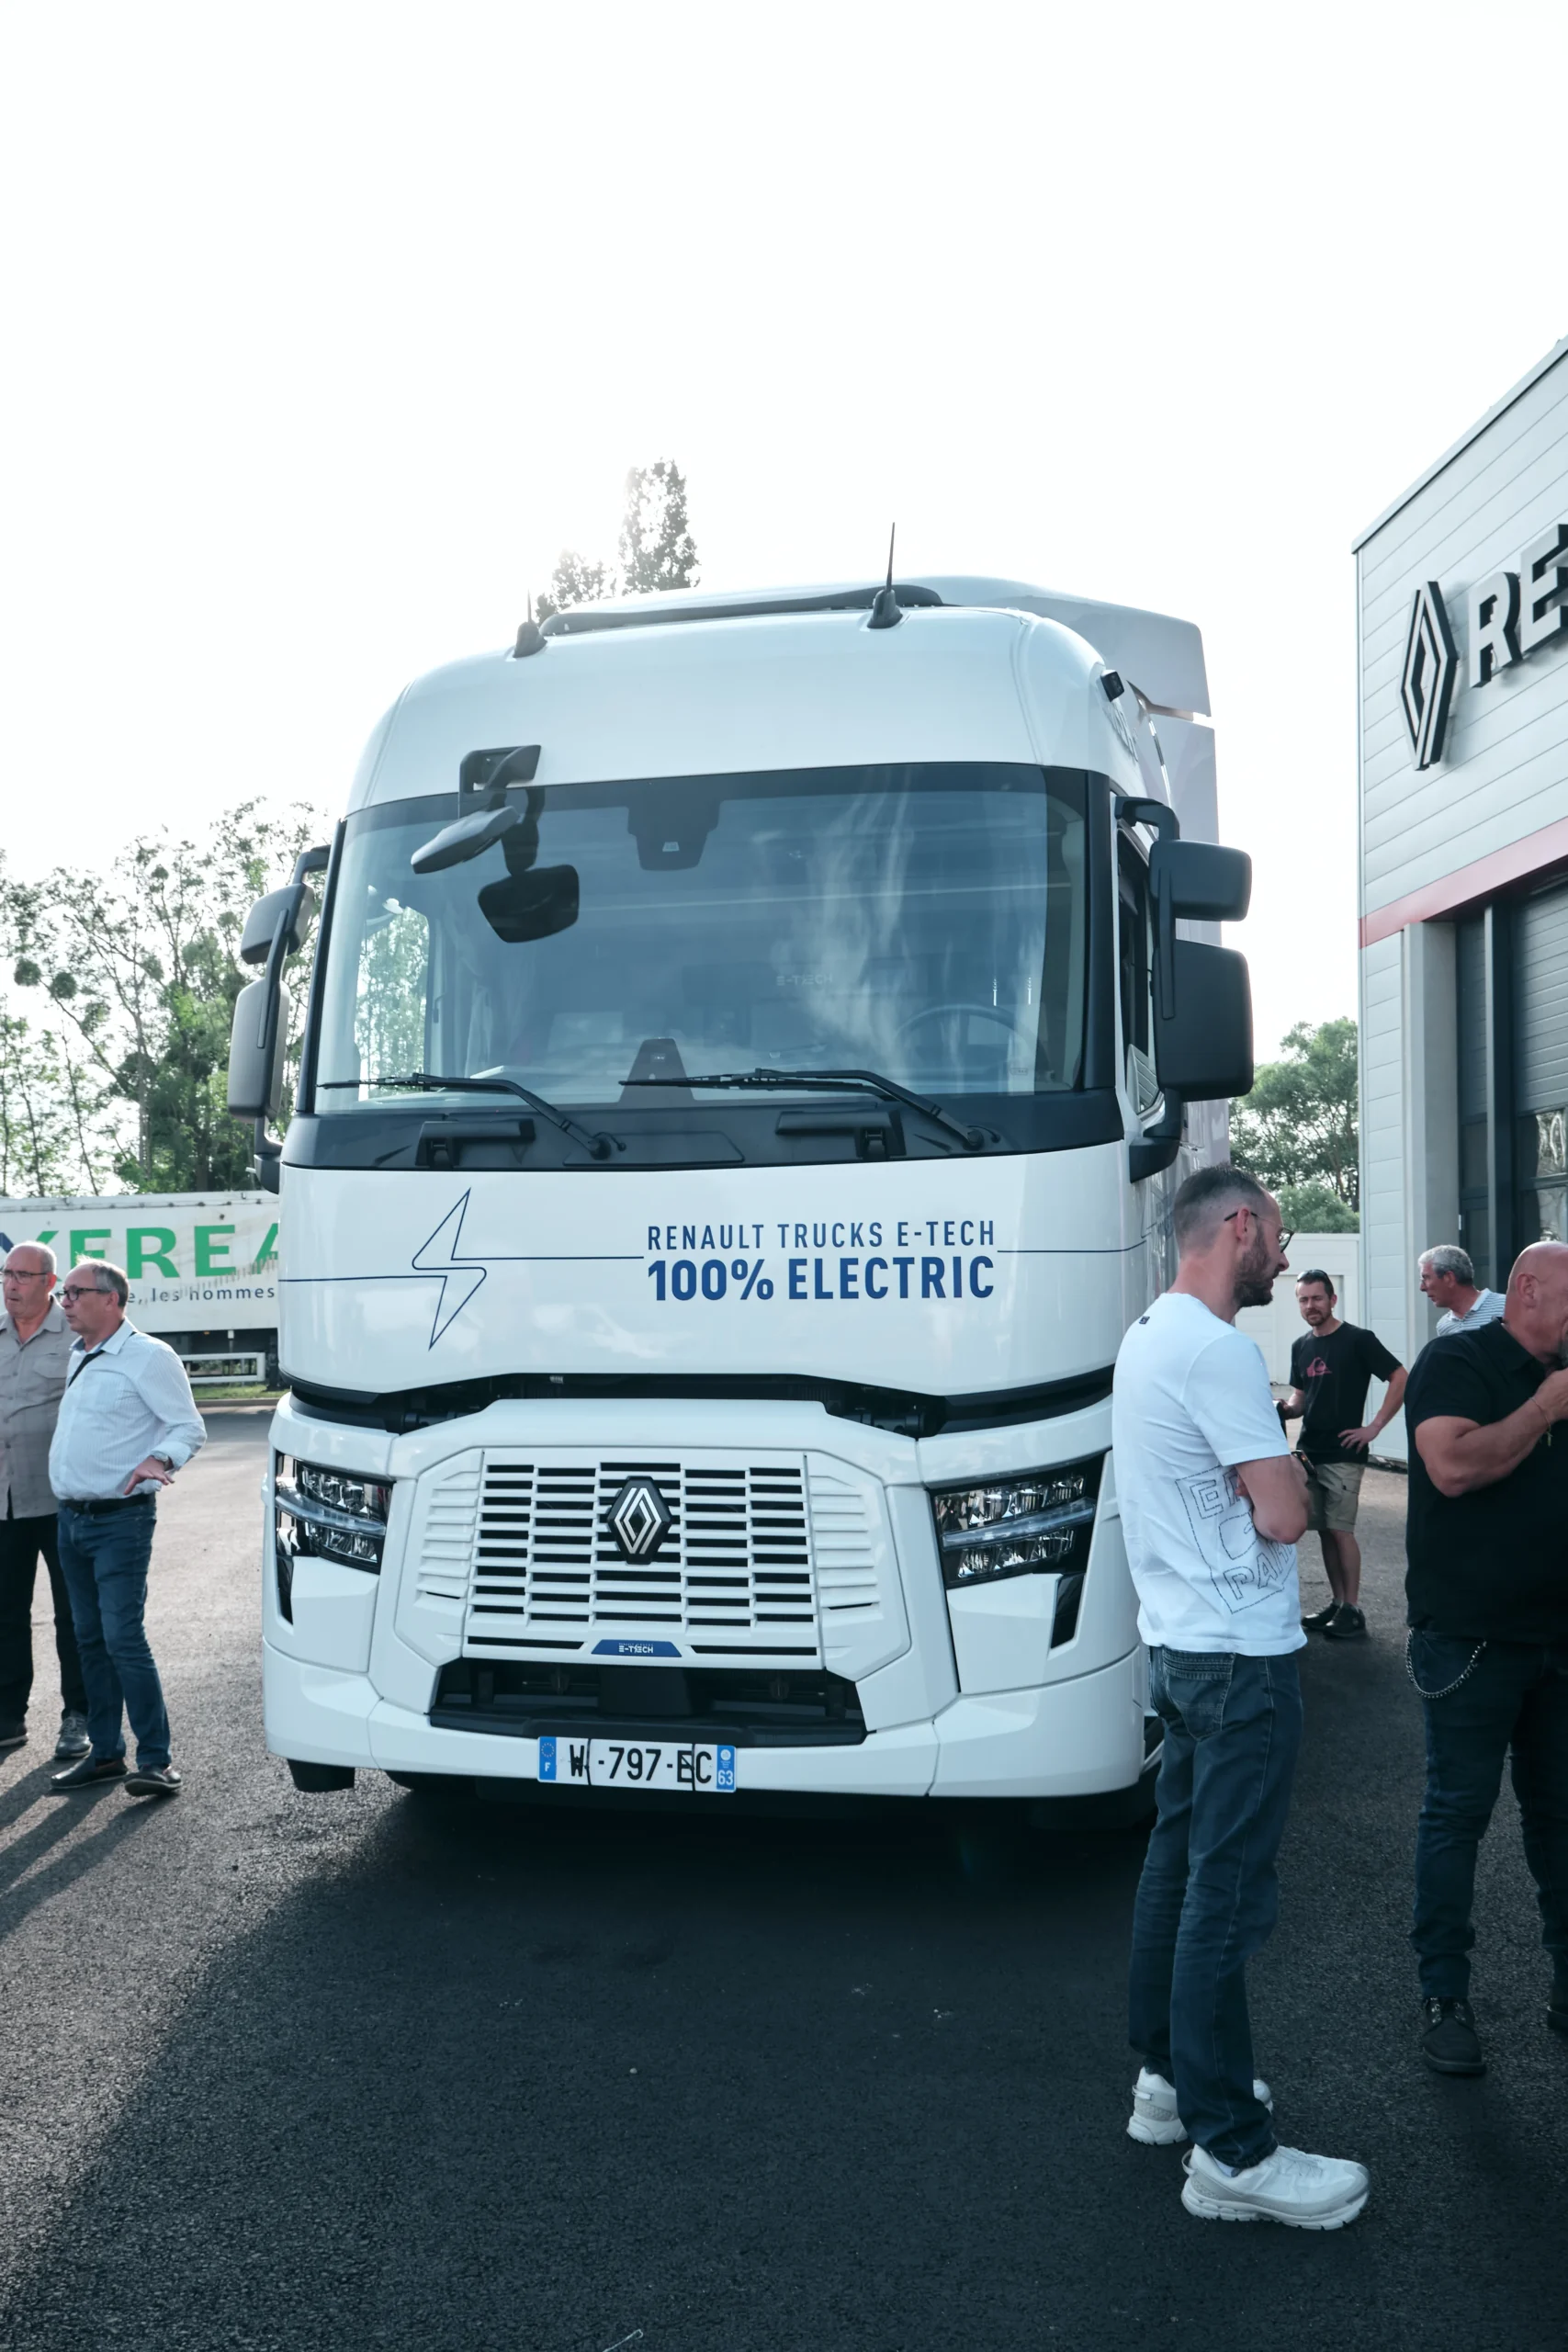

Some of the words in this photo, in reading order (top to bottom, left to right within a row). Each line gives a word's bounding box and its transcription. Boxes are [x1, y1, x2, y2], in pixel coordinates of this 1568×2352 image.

[648, 1224, 765, 1250] RENAULT
[778, 1222, 884, 1249] TRUCKS
[897, 1220, 995, 1247] E-TECH
[0, 1223, 278, 1283] ERE
[648, 1258, 774, 1302] 100%
[787, 1255, 995, 1300] ELECTRIC
[189, 1286, 275, 1301] hommes
[618, 1645, 654, 1654] E-TECH
[544, 1761, 551, 1772] F
[717, 1770, 734, 1786] 63
